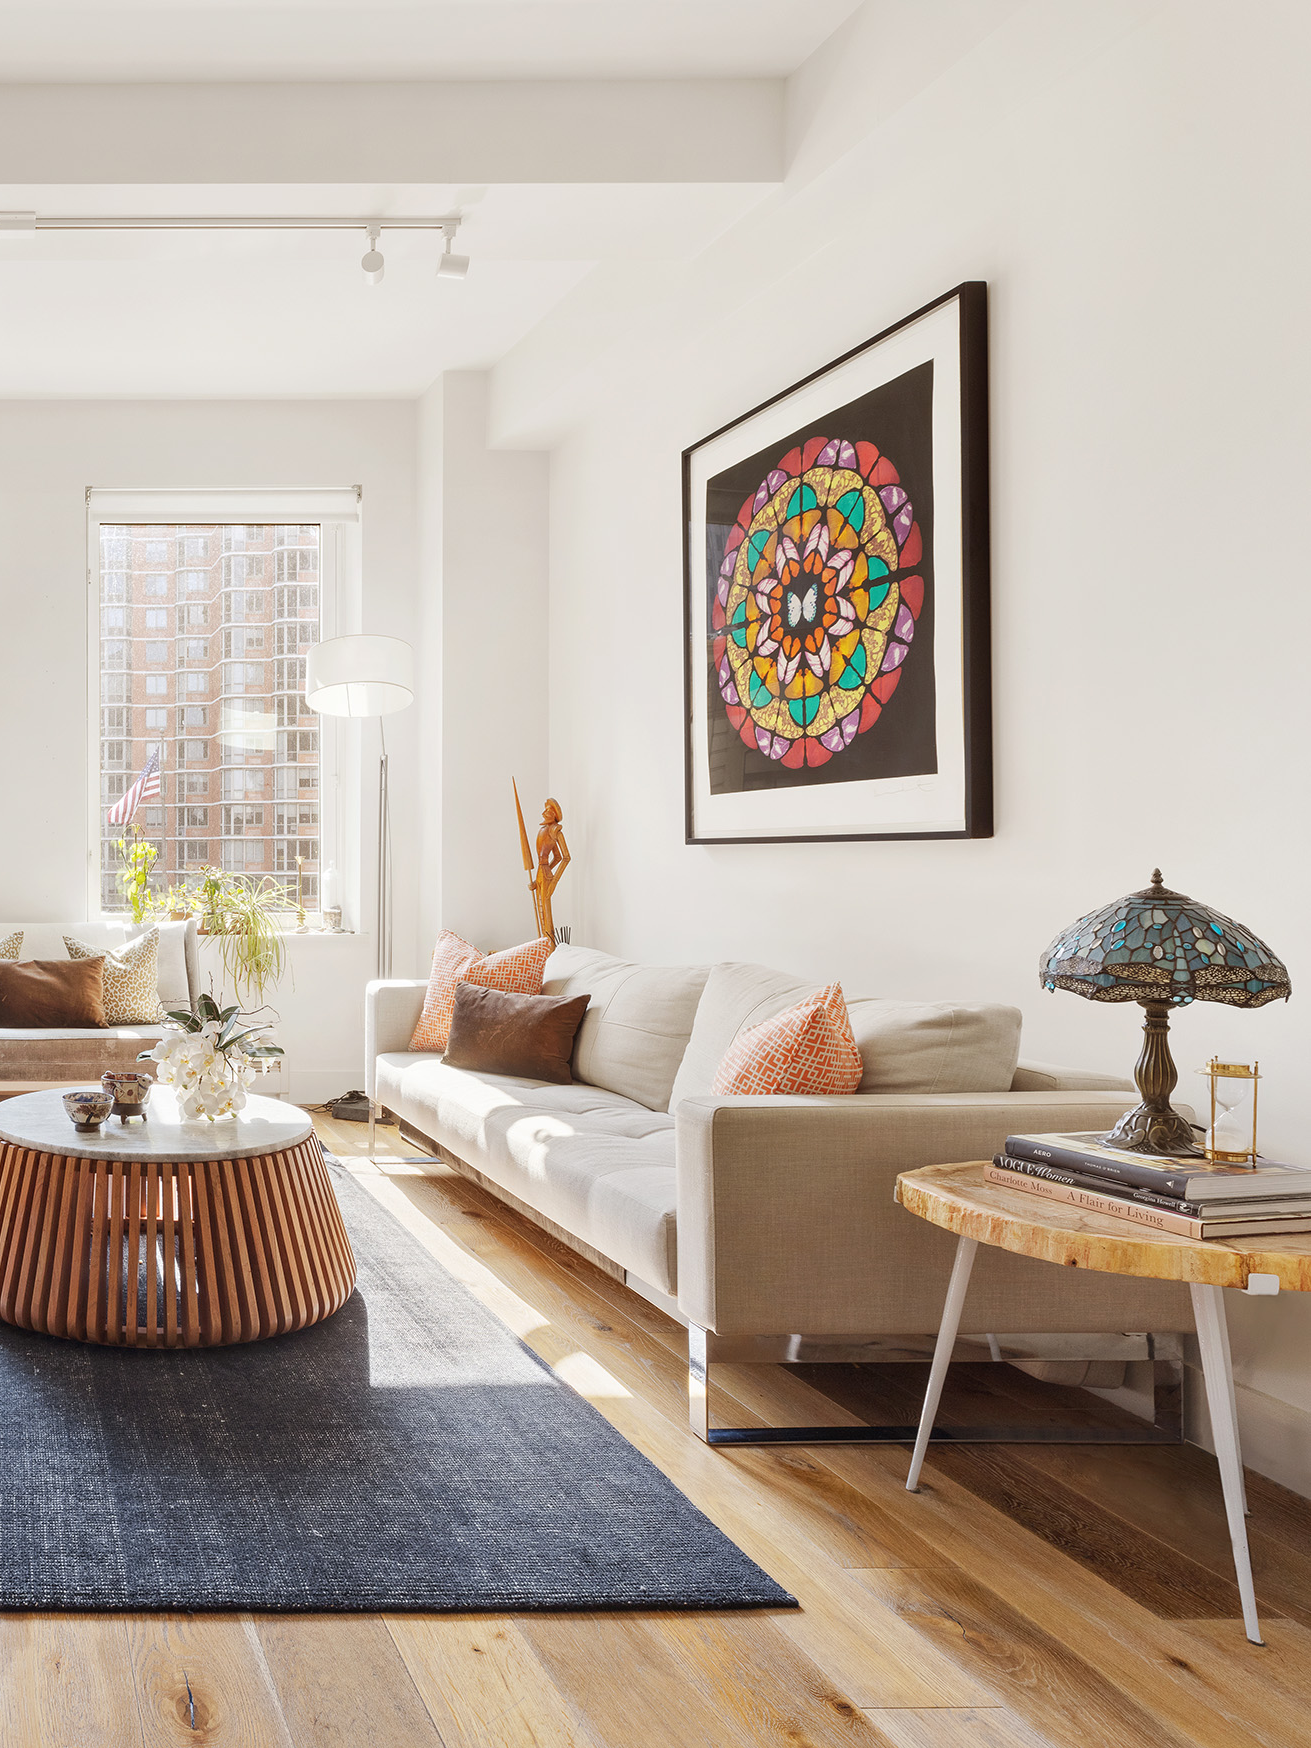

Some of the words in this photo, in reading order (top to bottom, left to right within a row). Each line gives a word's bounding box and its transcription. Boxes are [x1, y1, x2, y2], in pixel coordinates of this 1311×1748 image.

[1033, 1148, 1052, 1158] AERO
[998, 1156, 1036, 1176] VOGUE
[1034, 1166, 1076, 1185] Women
[1084, 1161, 1102, 1170] THOMAS
[1102, 1165, 1121, 1174] O'BRIEN
[990, 1170, 1028, 1189] Charlotte
[1030, 1180, 1053, 1195] Moss
[1067, 1191, 1075, 1201] A
[1079, 1193, 1104, 1209] Flair
[1107, 1201, 1123, 1214] for
[1127, 1206, 1164, 1228] Living
[1133, 1191, 1156, 1204] Georgina
[1156, 1197, 1176, 1208] Howell
